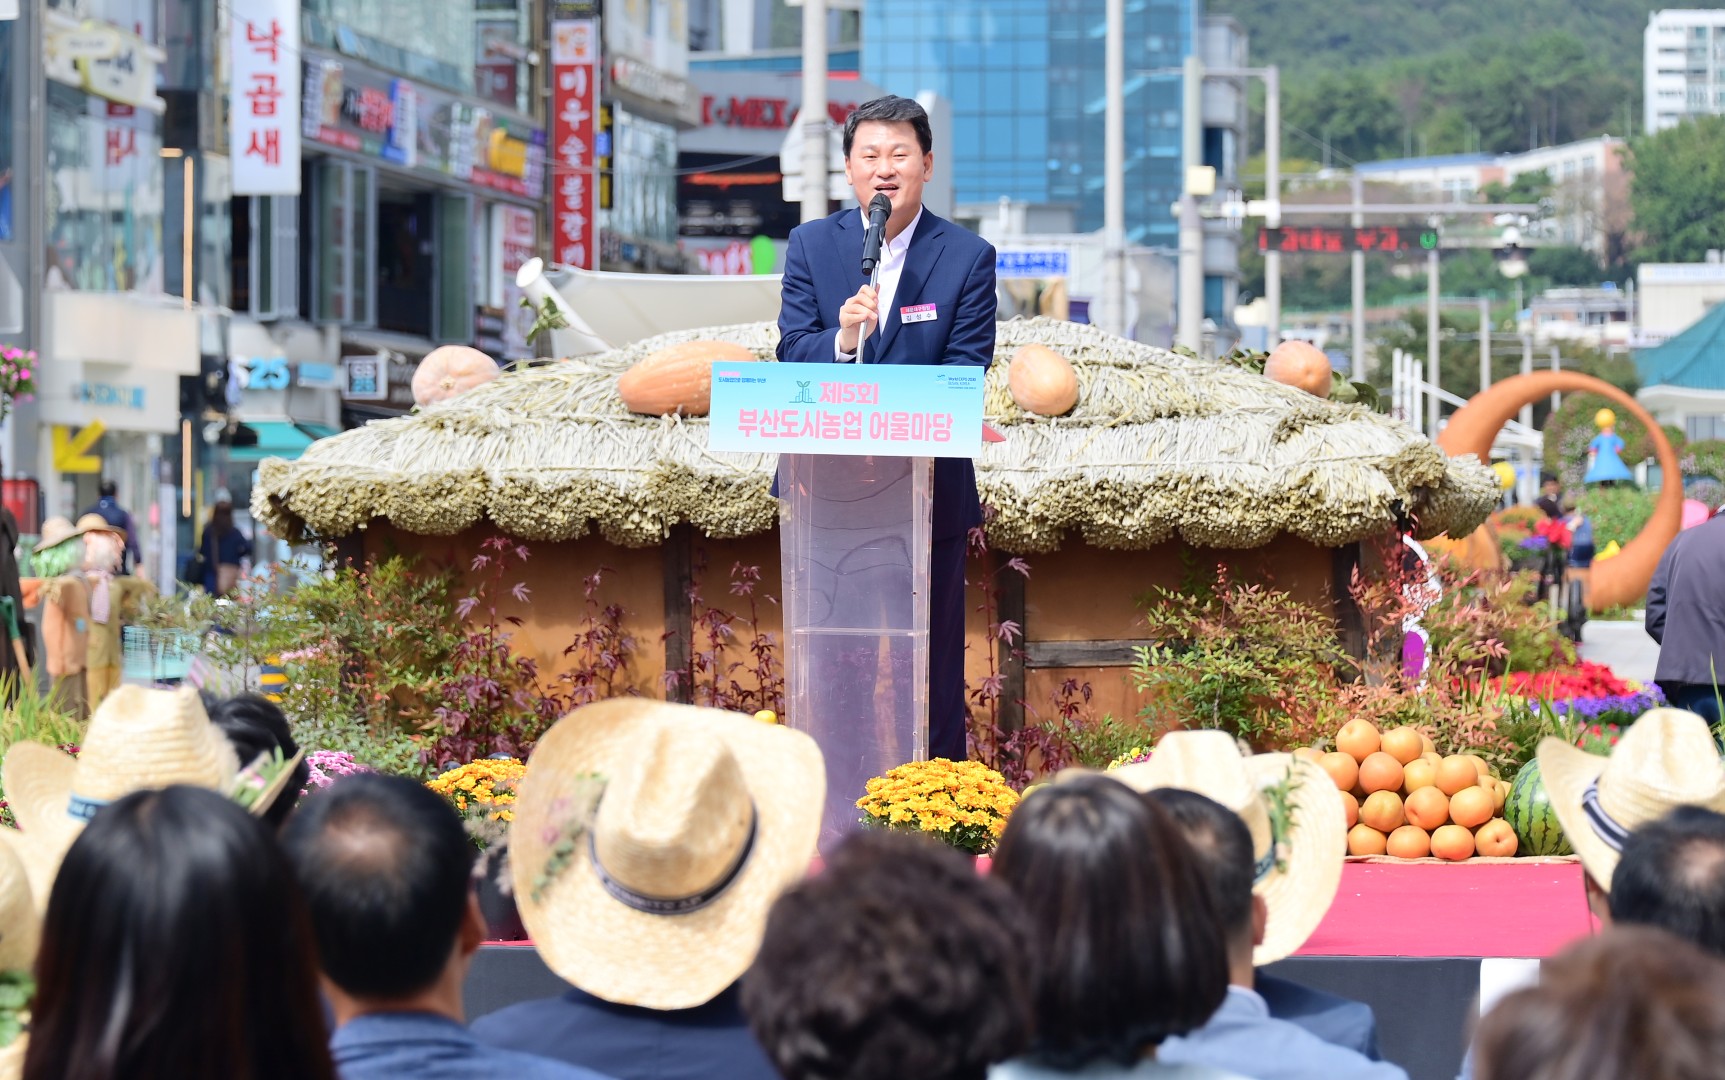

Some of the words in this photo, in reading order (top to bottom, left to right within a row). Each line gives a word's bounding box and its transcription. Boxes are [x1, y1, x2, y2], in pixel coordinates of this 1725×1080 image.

[246, 20, 282, 166] 낙곱새
[819, 381, 880, 405] 제5회
[738, 408, 863, 440] 부산도시농업
[869, 411, 954, 442] 어울마당
